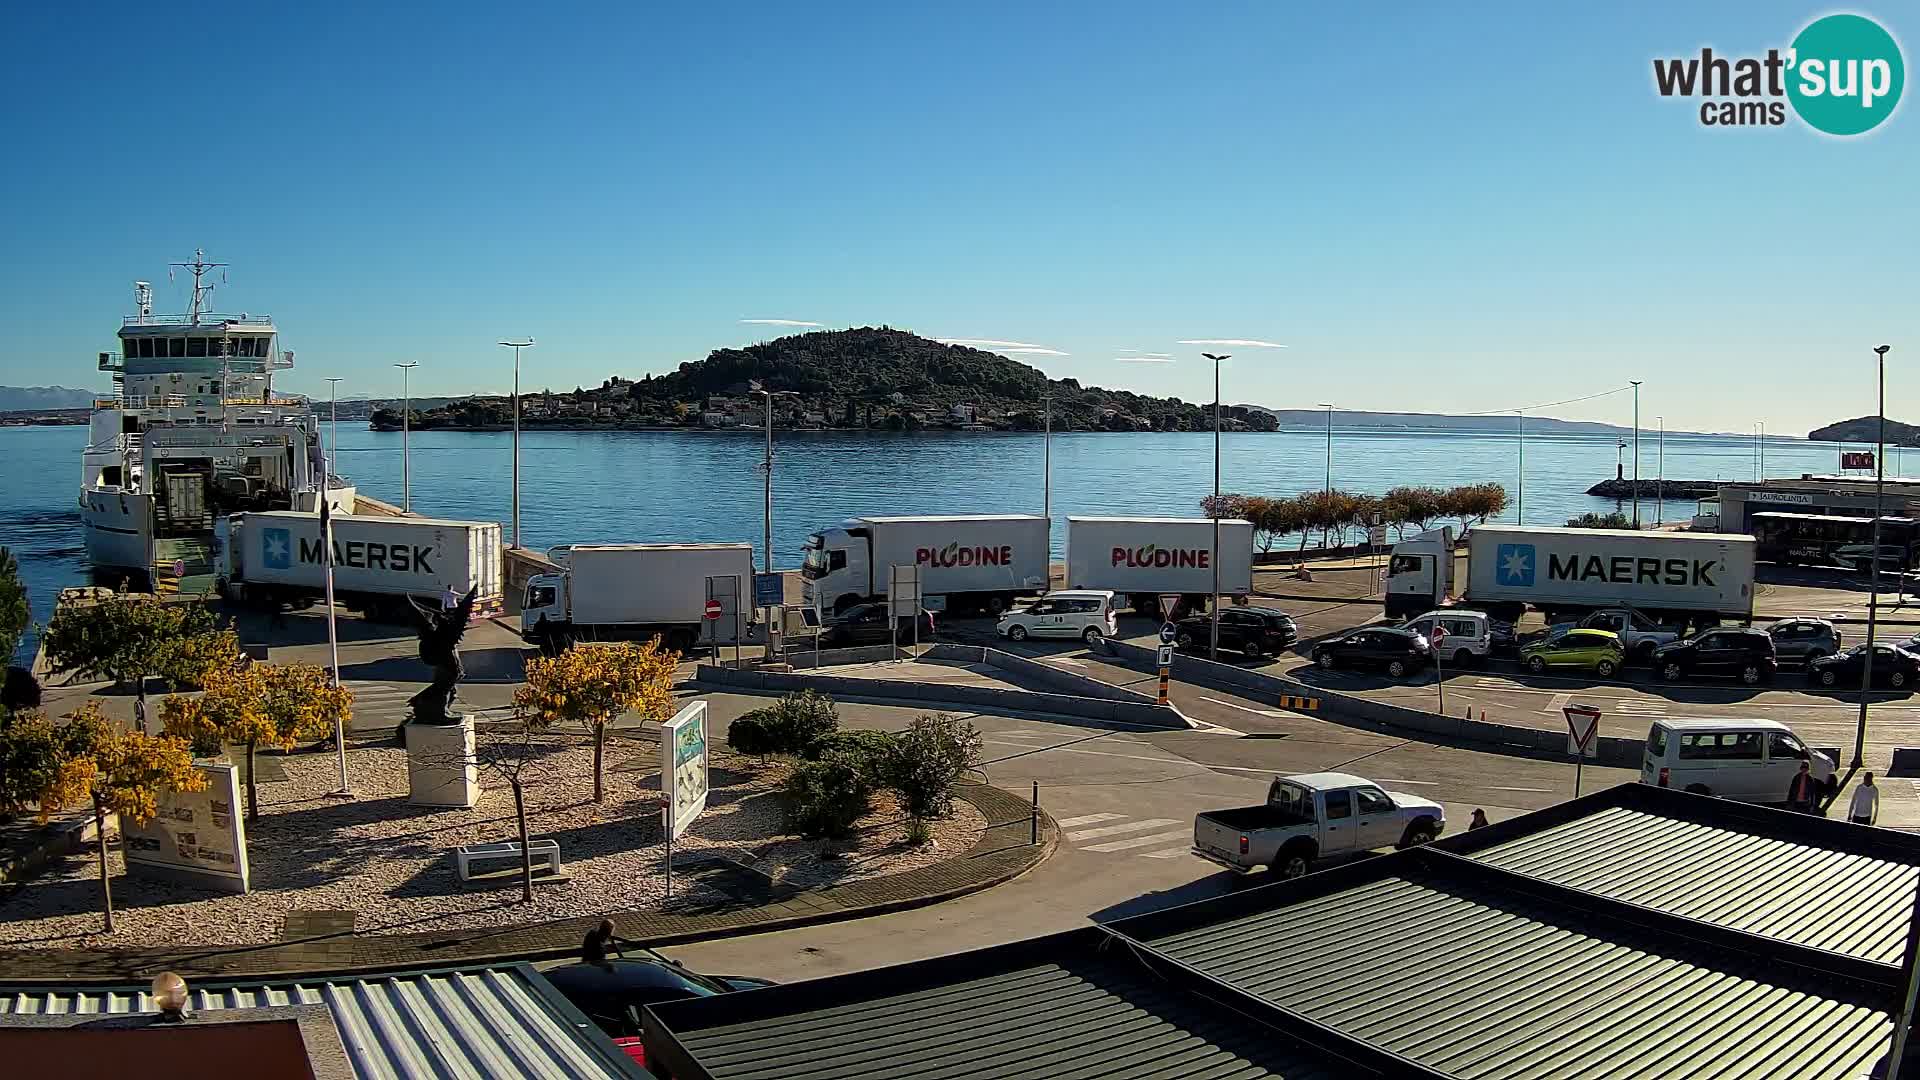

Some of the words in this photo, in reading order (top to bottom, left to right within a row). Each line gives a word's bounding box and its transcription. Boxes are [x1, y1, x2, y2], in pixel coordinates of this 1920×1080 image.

[300, 537, 434, 574] MAERSK
[916, 545, 1012, 568] PLODINE
[1112, 547, 1209, 568] PLODINE
[1548, 553, 1716, 587] MAERSK
